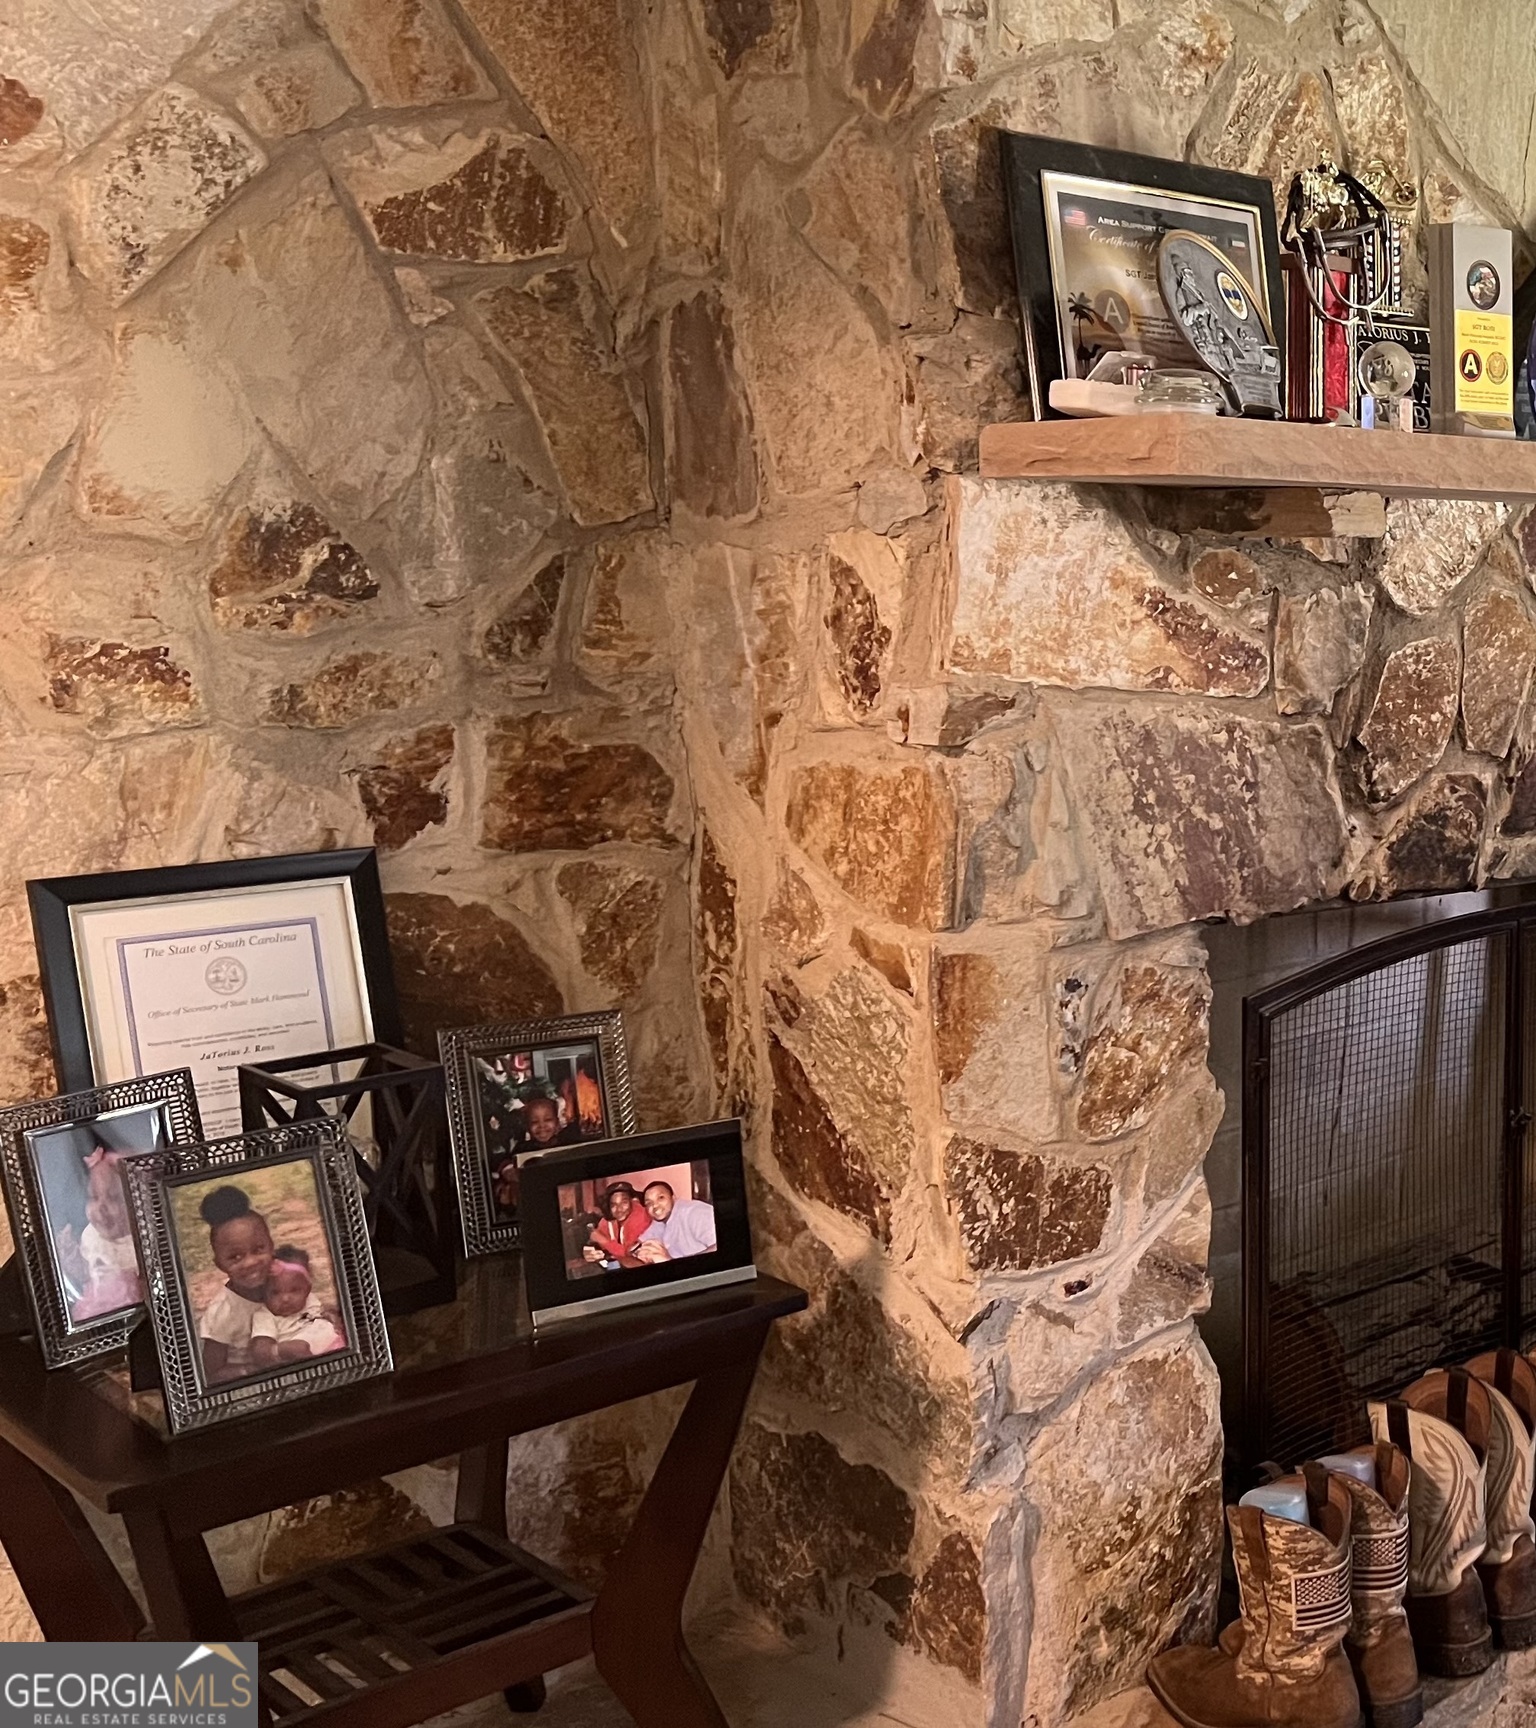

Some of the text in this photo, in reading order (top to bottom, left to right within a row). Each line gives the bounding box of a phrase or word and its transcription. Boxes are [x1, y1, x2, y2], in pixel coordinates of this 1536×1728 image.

[1097, 216, 1120, 226] AREA
[1121, 220, 1157, 233] SUPPORT
[1086, 225, 1143, 250] Certificate
[1125, 268, 1141, 279] SGT
[1103, 297, 1123, 324] A
[1357, 325, 1409, 341] ATORIUS
[1464, 353, 1478, 375] A
[144, 933, 297, 959] The State of South Carolina
[147, 1010, 172, 1020] Office
[182, 1003, 219, 1014] Secretary
[199, 1044, 276, 1061] JaTorius J. Ross
